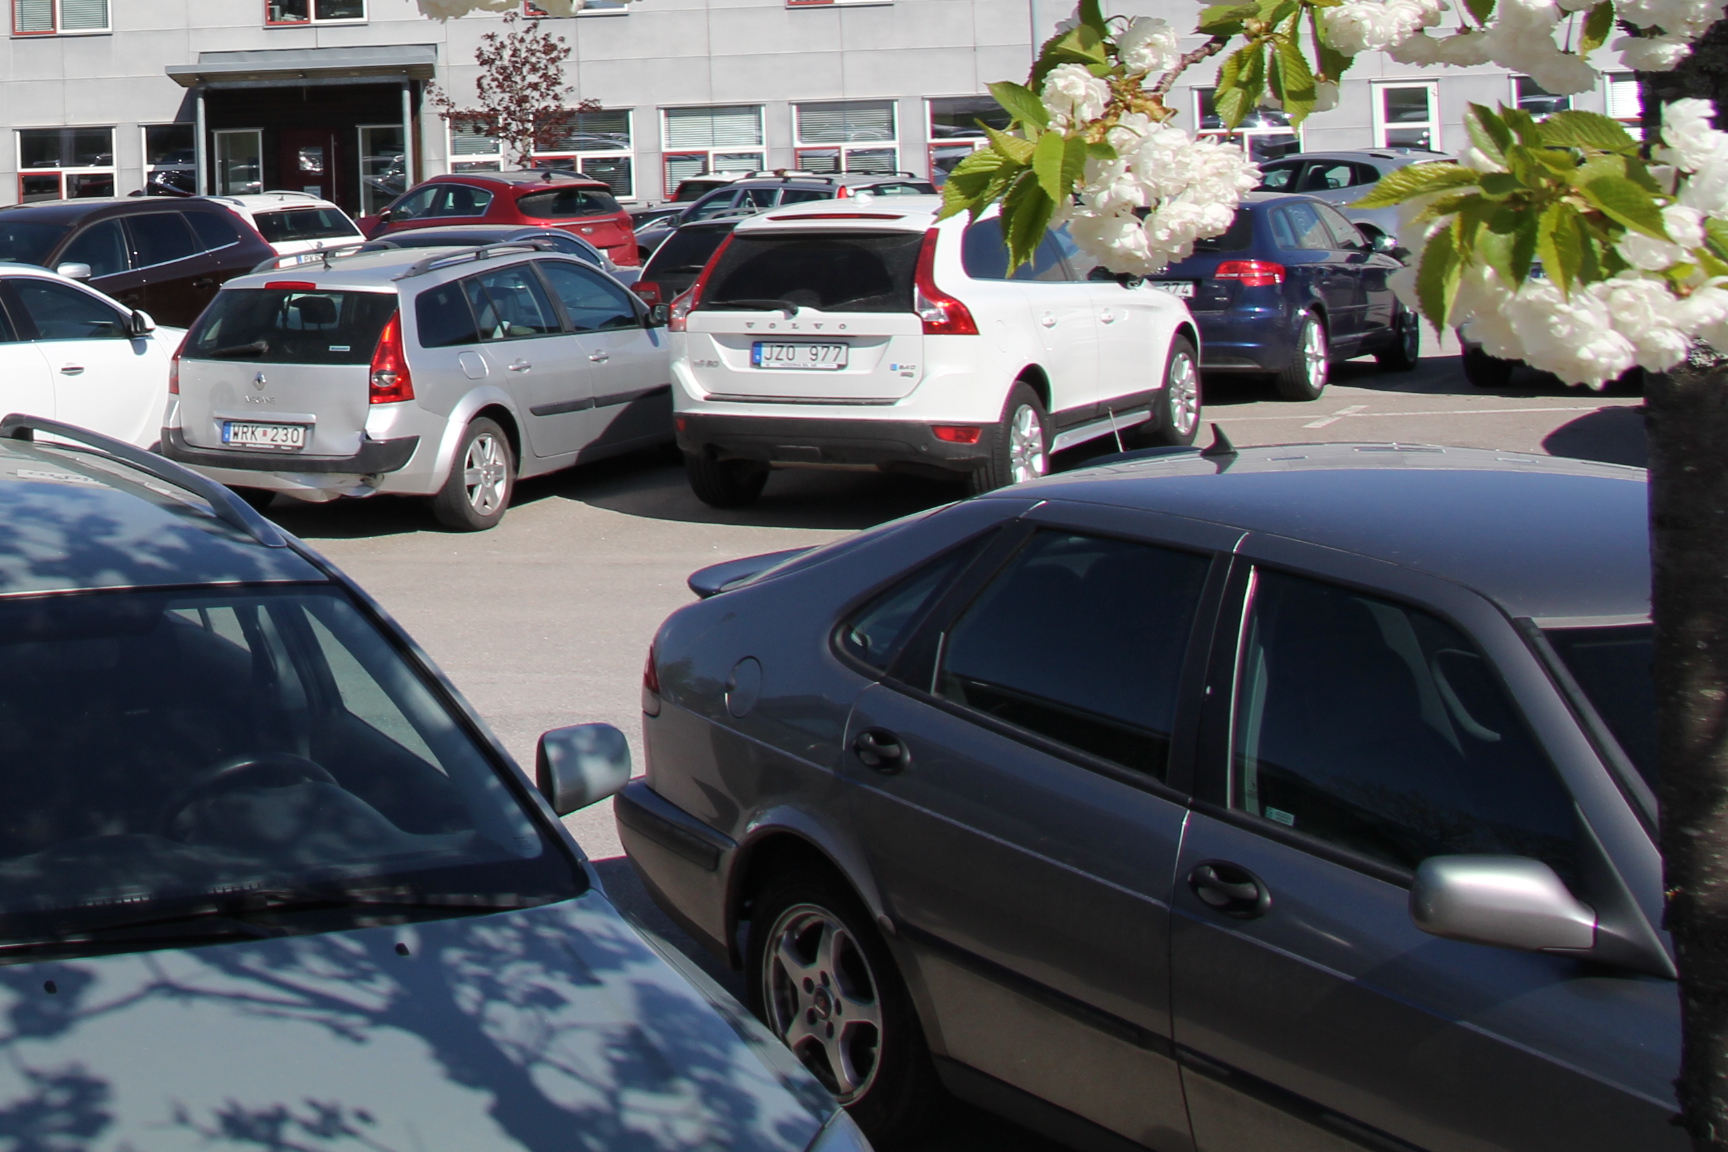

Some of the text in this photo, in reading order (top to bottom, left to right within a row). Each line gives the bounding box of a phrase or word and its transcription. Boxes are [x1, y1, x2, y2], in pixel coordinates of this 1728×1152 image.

[745, 322, 847, 330] VOLVO
[809, 346, 843, 362] 977
[232, 425, 300, 444] WRK 230
